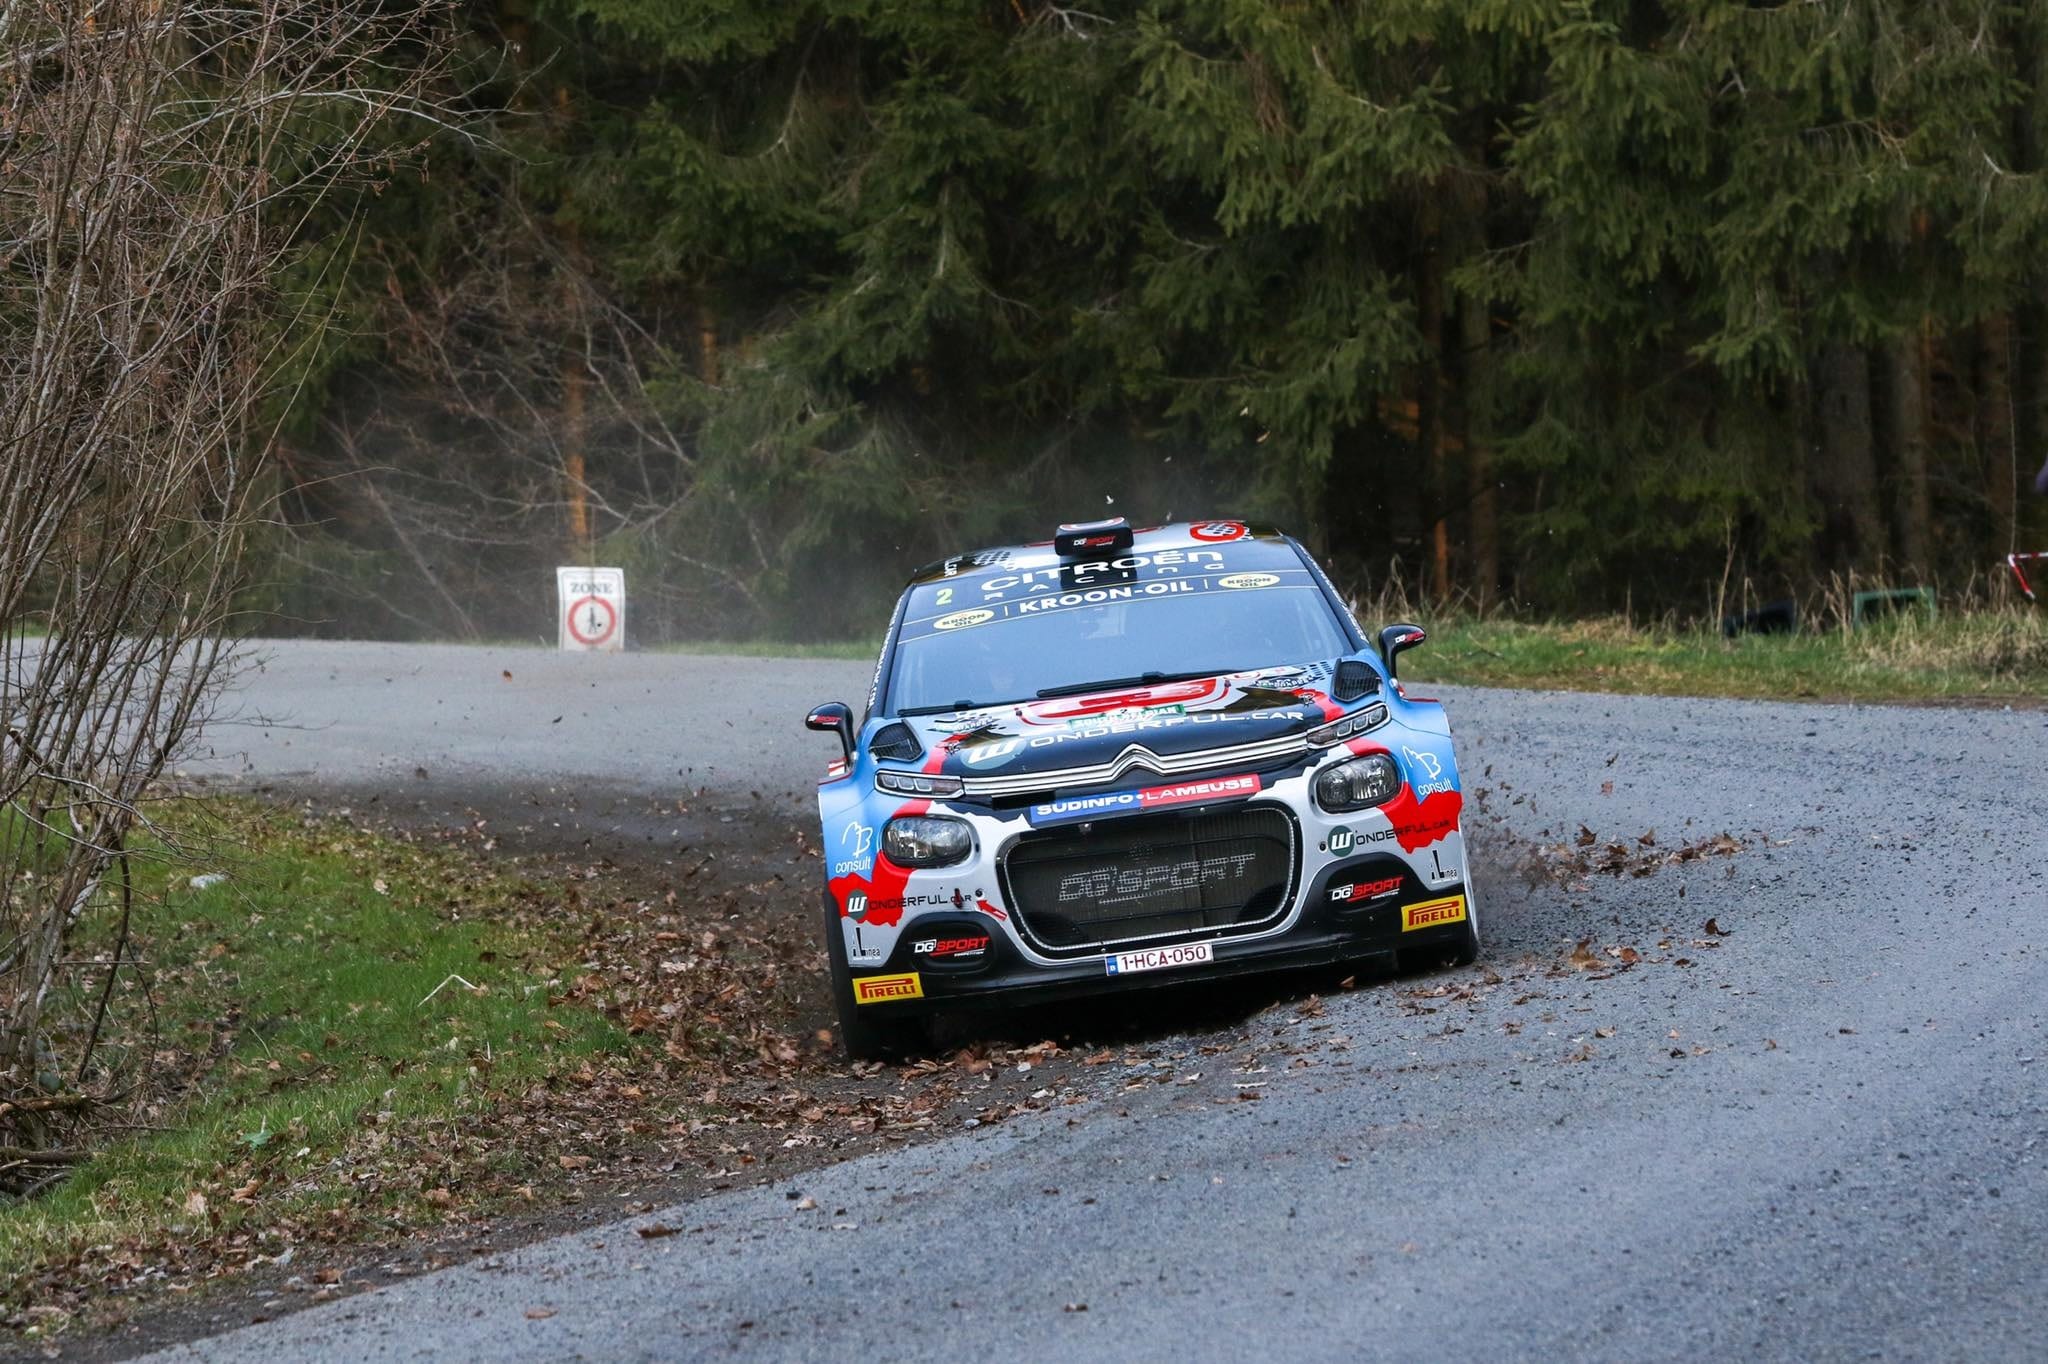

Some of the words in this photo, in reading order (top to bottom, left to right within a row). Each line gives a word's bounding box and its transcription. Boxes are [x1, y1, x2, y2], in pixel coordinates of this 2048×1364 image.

[570, 582, 612, 594] ZONE
[936, 588, 953, 606] 2
[1020, 582, 1193, 613] KROON-OIL
[1417, 778, 1454, 797] consult
[835, 857, 871, 873] consult
[1408, 901, 1460, 927] PIRELLI
[1121, 946, 1206, 970] 1-HCA-050
[859, 978, 916, 999] PIRELLI
